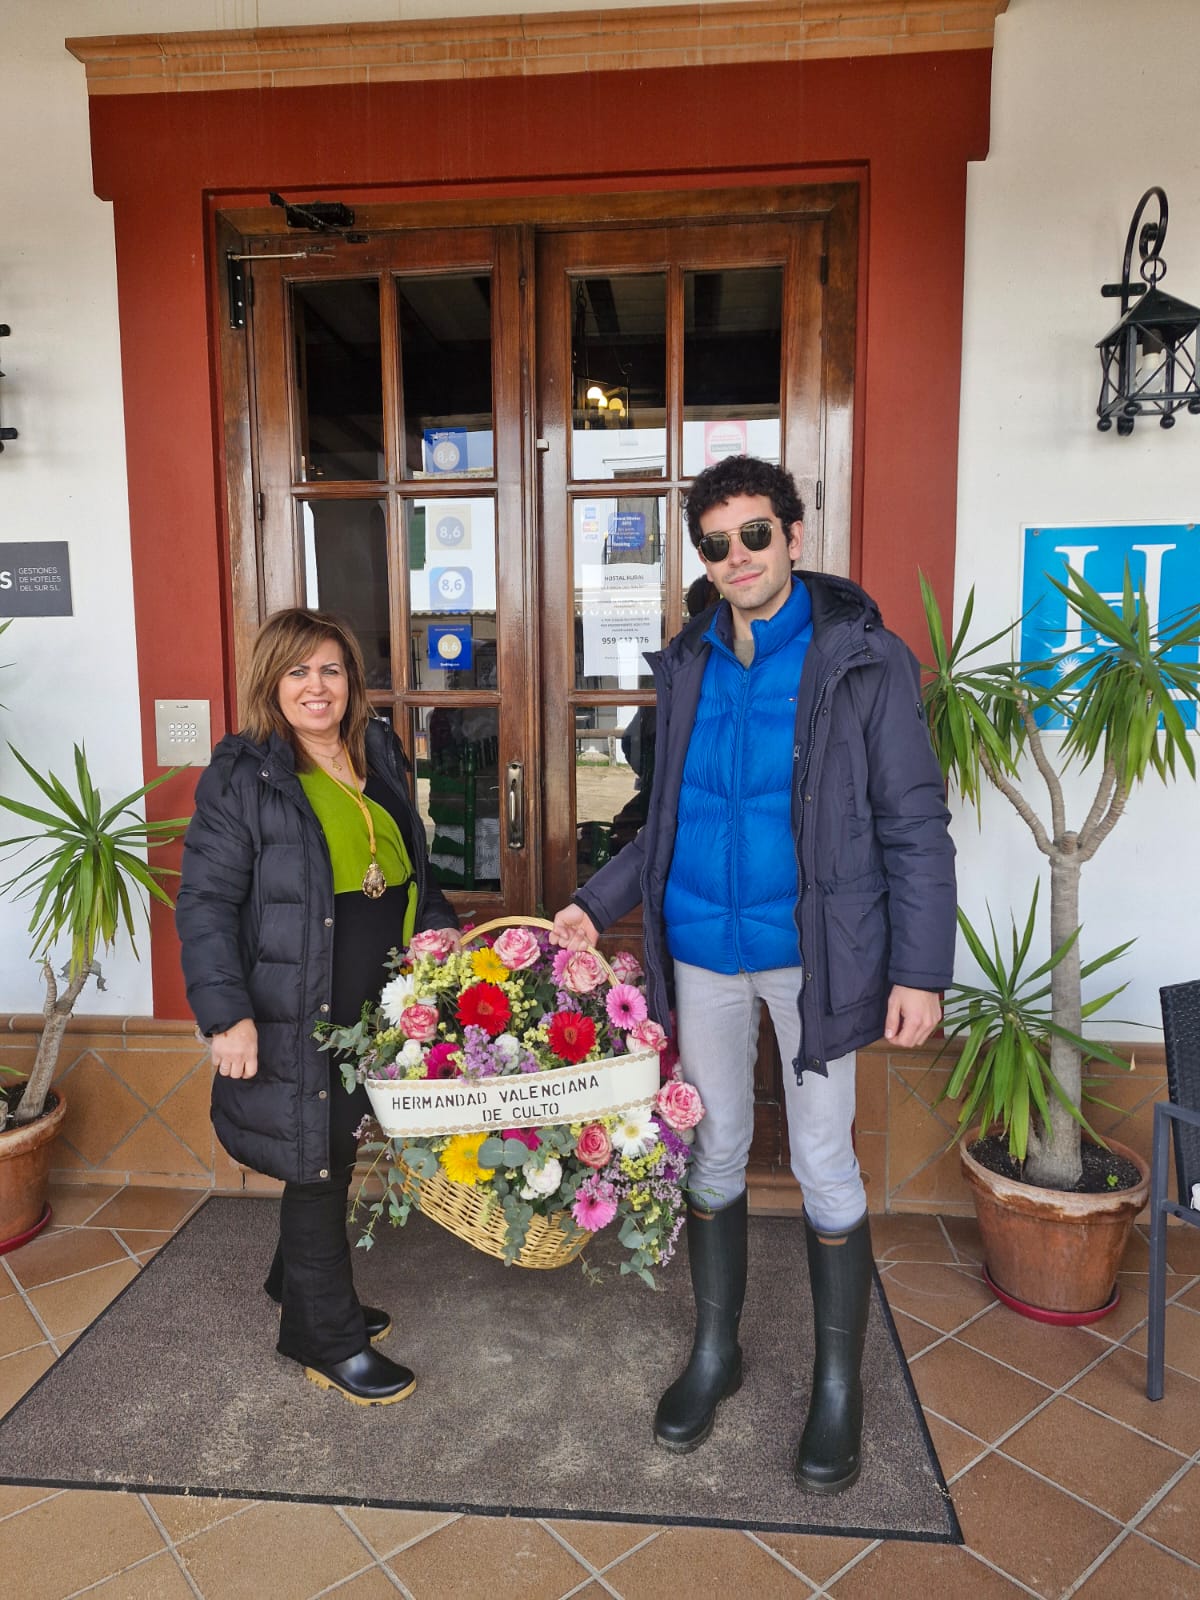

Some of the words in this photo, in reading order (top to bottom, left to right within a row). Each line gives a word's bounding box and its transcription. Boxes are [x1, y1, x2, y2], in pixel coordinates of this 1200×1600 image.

[440, 526, 461, 539] 8,6
[18, 566, 58, 575] GESTIONES
[30, 575, 62, 583] HOTELES
[441, 579, 462, 592] 8,6
[601, 637, 617, 645] 959
[392, 1091, 488, 1111] HERMANDAD
[498, 1074, 600, 1104] VALENCIANA
[482, 1107, 502, 1122] DE
[512, 1102, 560, 1119] CULTO
